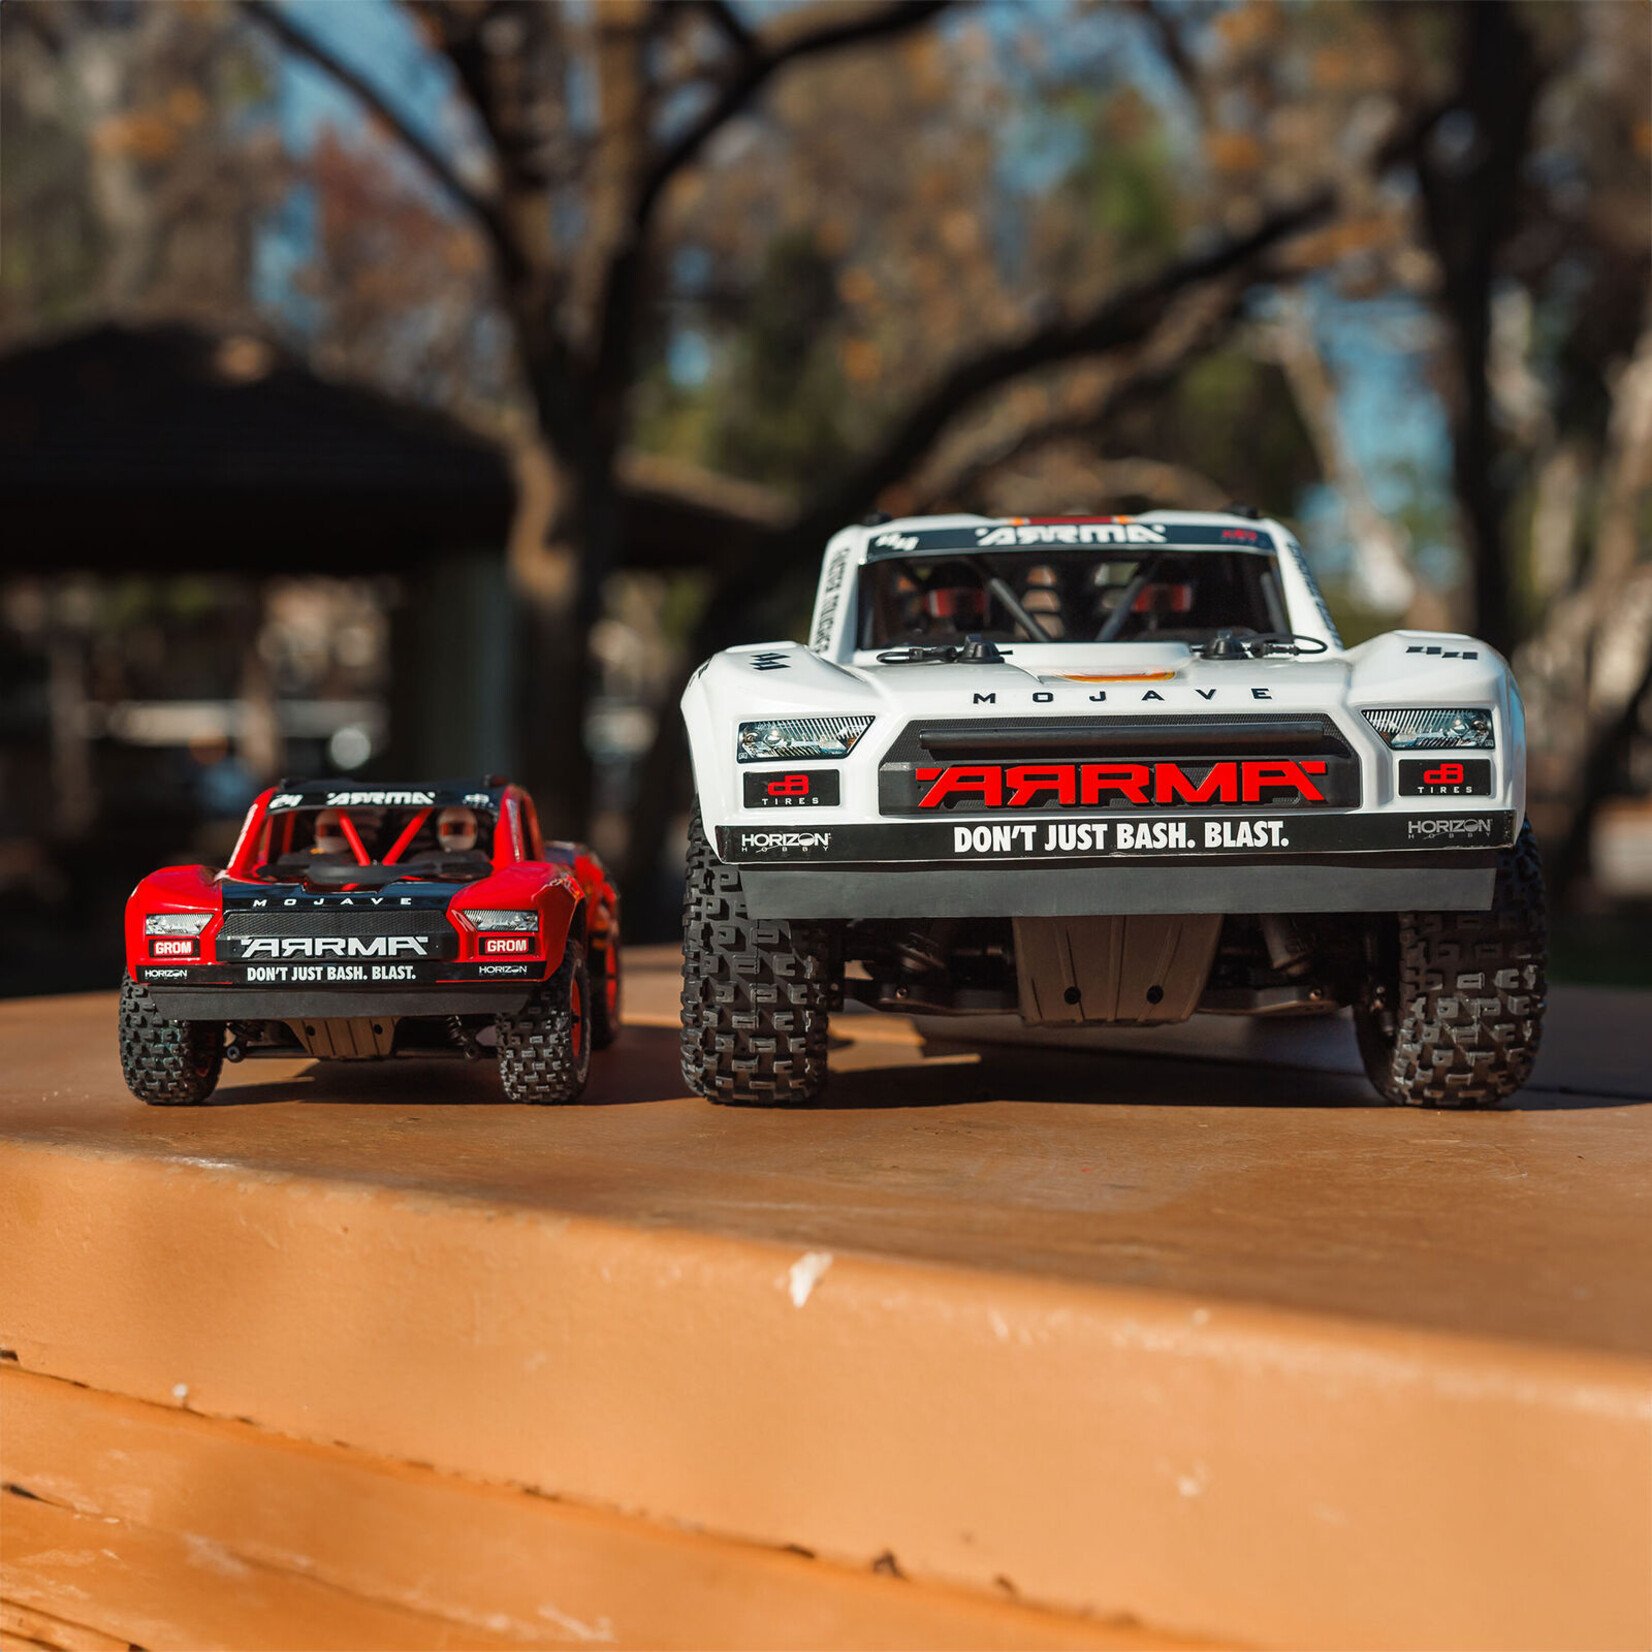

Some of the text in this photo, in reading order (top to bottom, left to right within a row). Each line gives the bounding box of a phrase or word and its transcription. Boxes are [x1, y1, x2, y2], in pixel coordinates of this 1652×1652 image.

[975, 524, 1167, 547] ARRMA
[972, 687, 1273, 705] MOJAVE
[915, 760, 1328, 809] ARRMA
[1417, 786, 1473, 794] TIRES
[761, 797, 820, 806] TIRES
[1408, 818, 1491, 834] HORIZON
[741, 832, 829, 847] HORIZON
[953, 820, 1290, 853] DON'T JUST BASH. BLAST.
[741, 846, 830, 854] HOBBY
[252, 897, 412, 908] MOJAVE
[155, 941, 192, 955] GROM
[241, 936, 429, 958] ARRMA
[487, 939, 527, 953] GROM
[144, 969, 188, 978] HORIZON
[247, 965, 417, 982] DON'T JUST BASH. BLAST.
[478, 965, 528, 974] HORIZON
